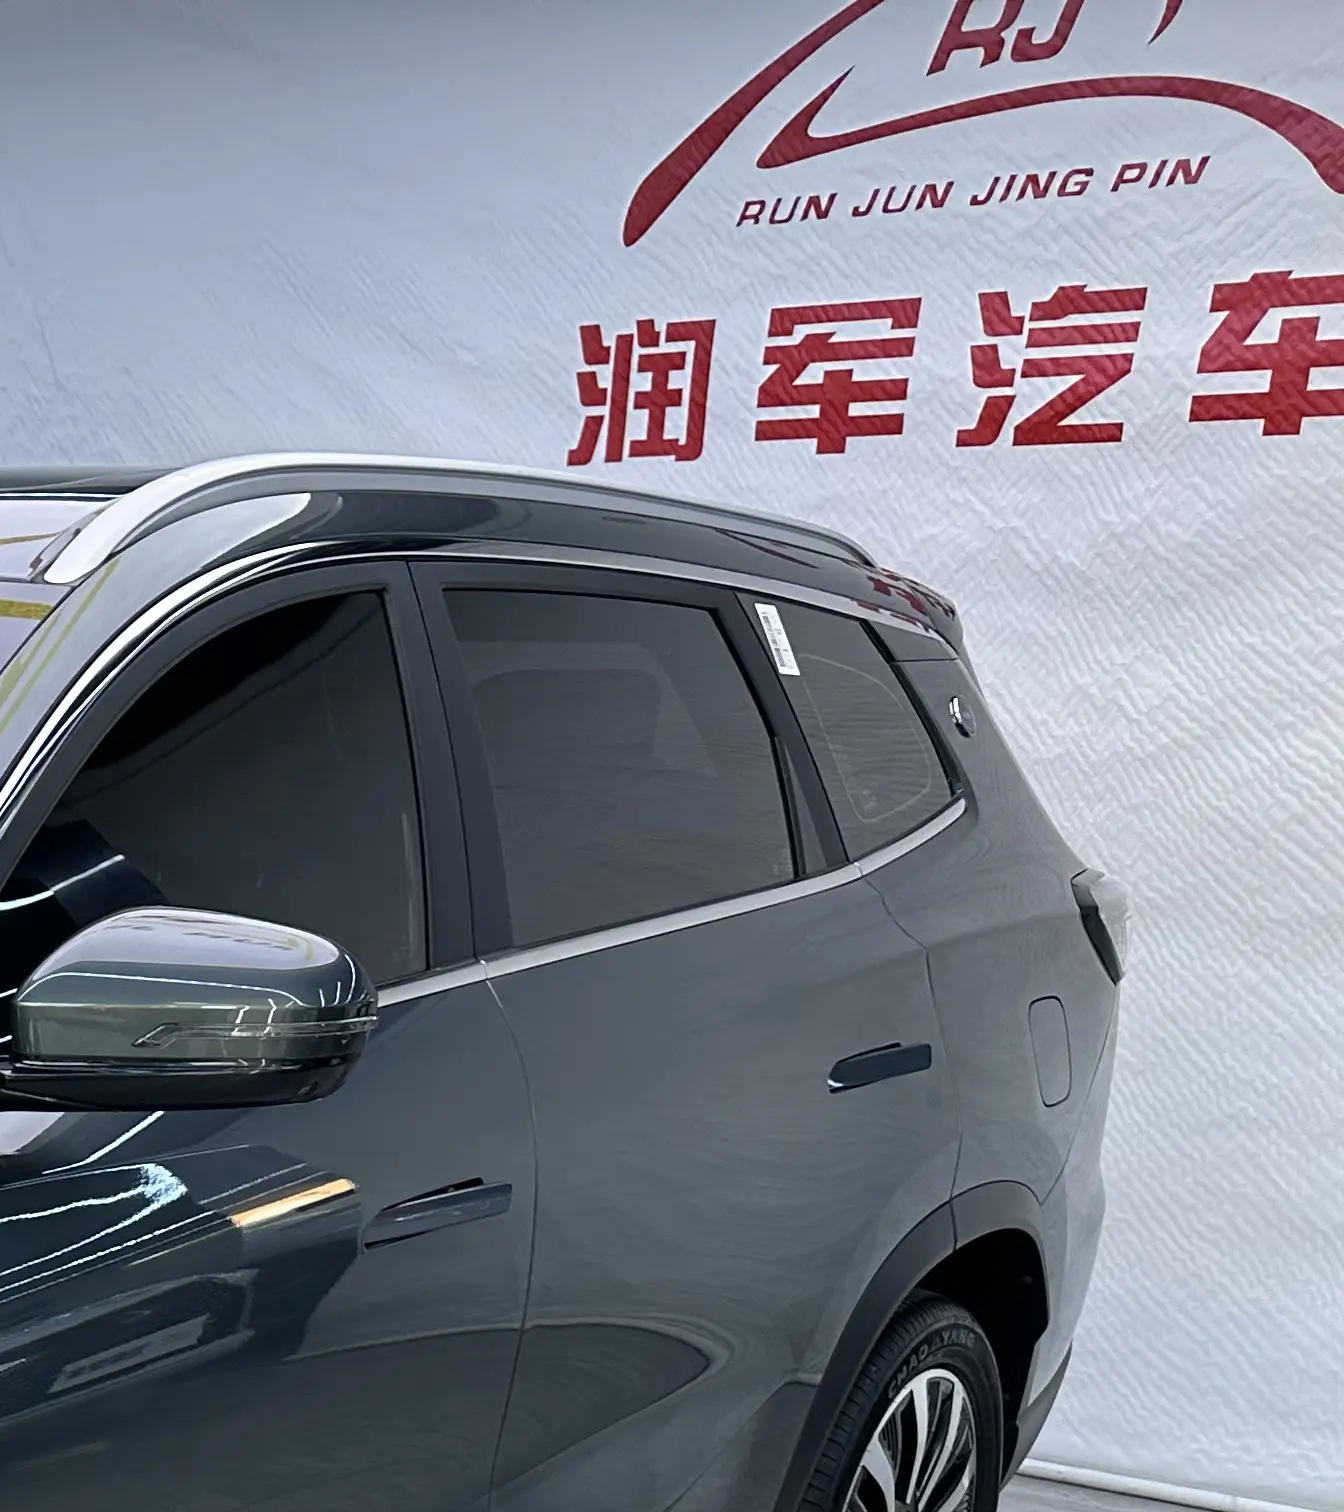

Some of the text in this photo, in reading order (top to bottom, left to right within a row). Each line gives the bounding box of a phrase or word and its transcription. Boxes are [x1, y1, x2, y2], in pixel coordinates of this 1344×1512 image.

[926, 0, 1085, 76] RJ
[736, 155, 1212, 227] RUN JUN JING PIN
[566, 270, 1344, 467] 润军汽车
